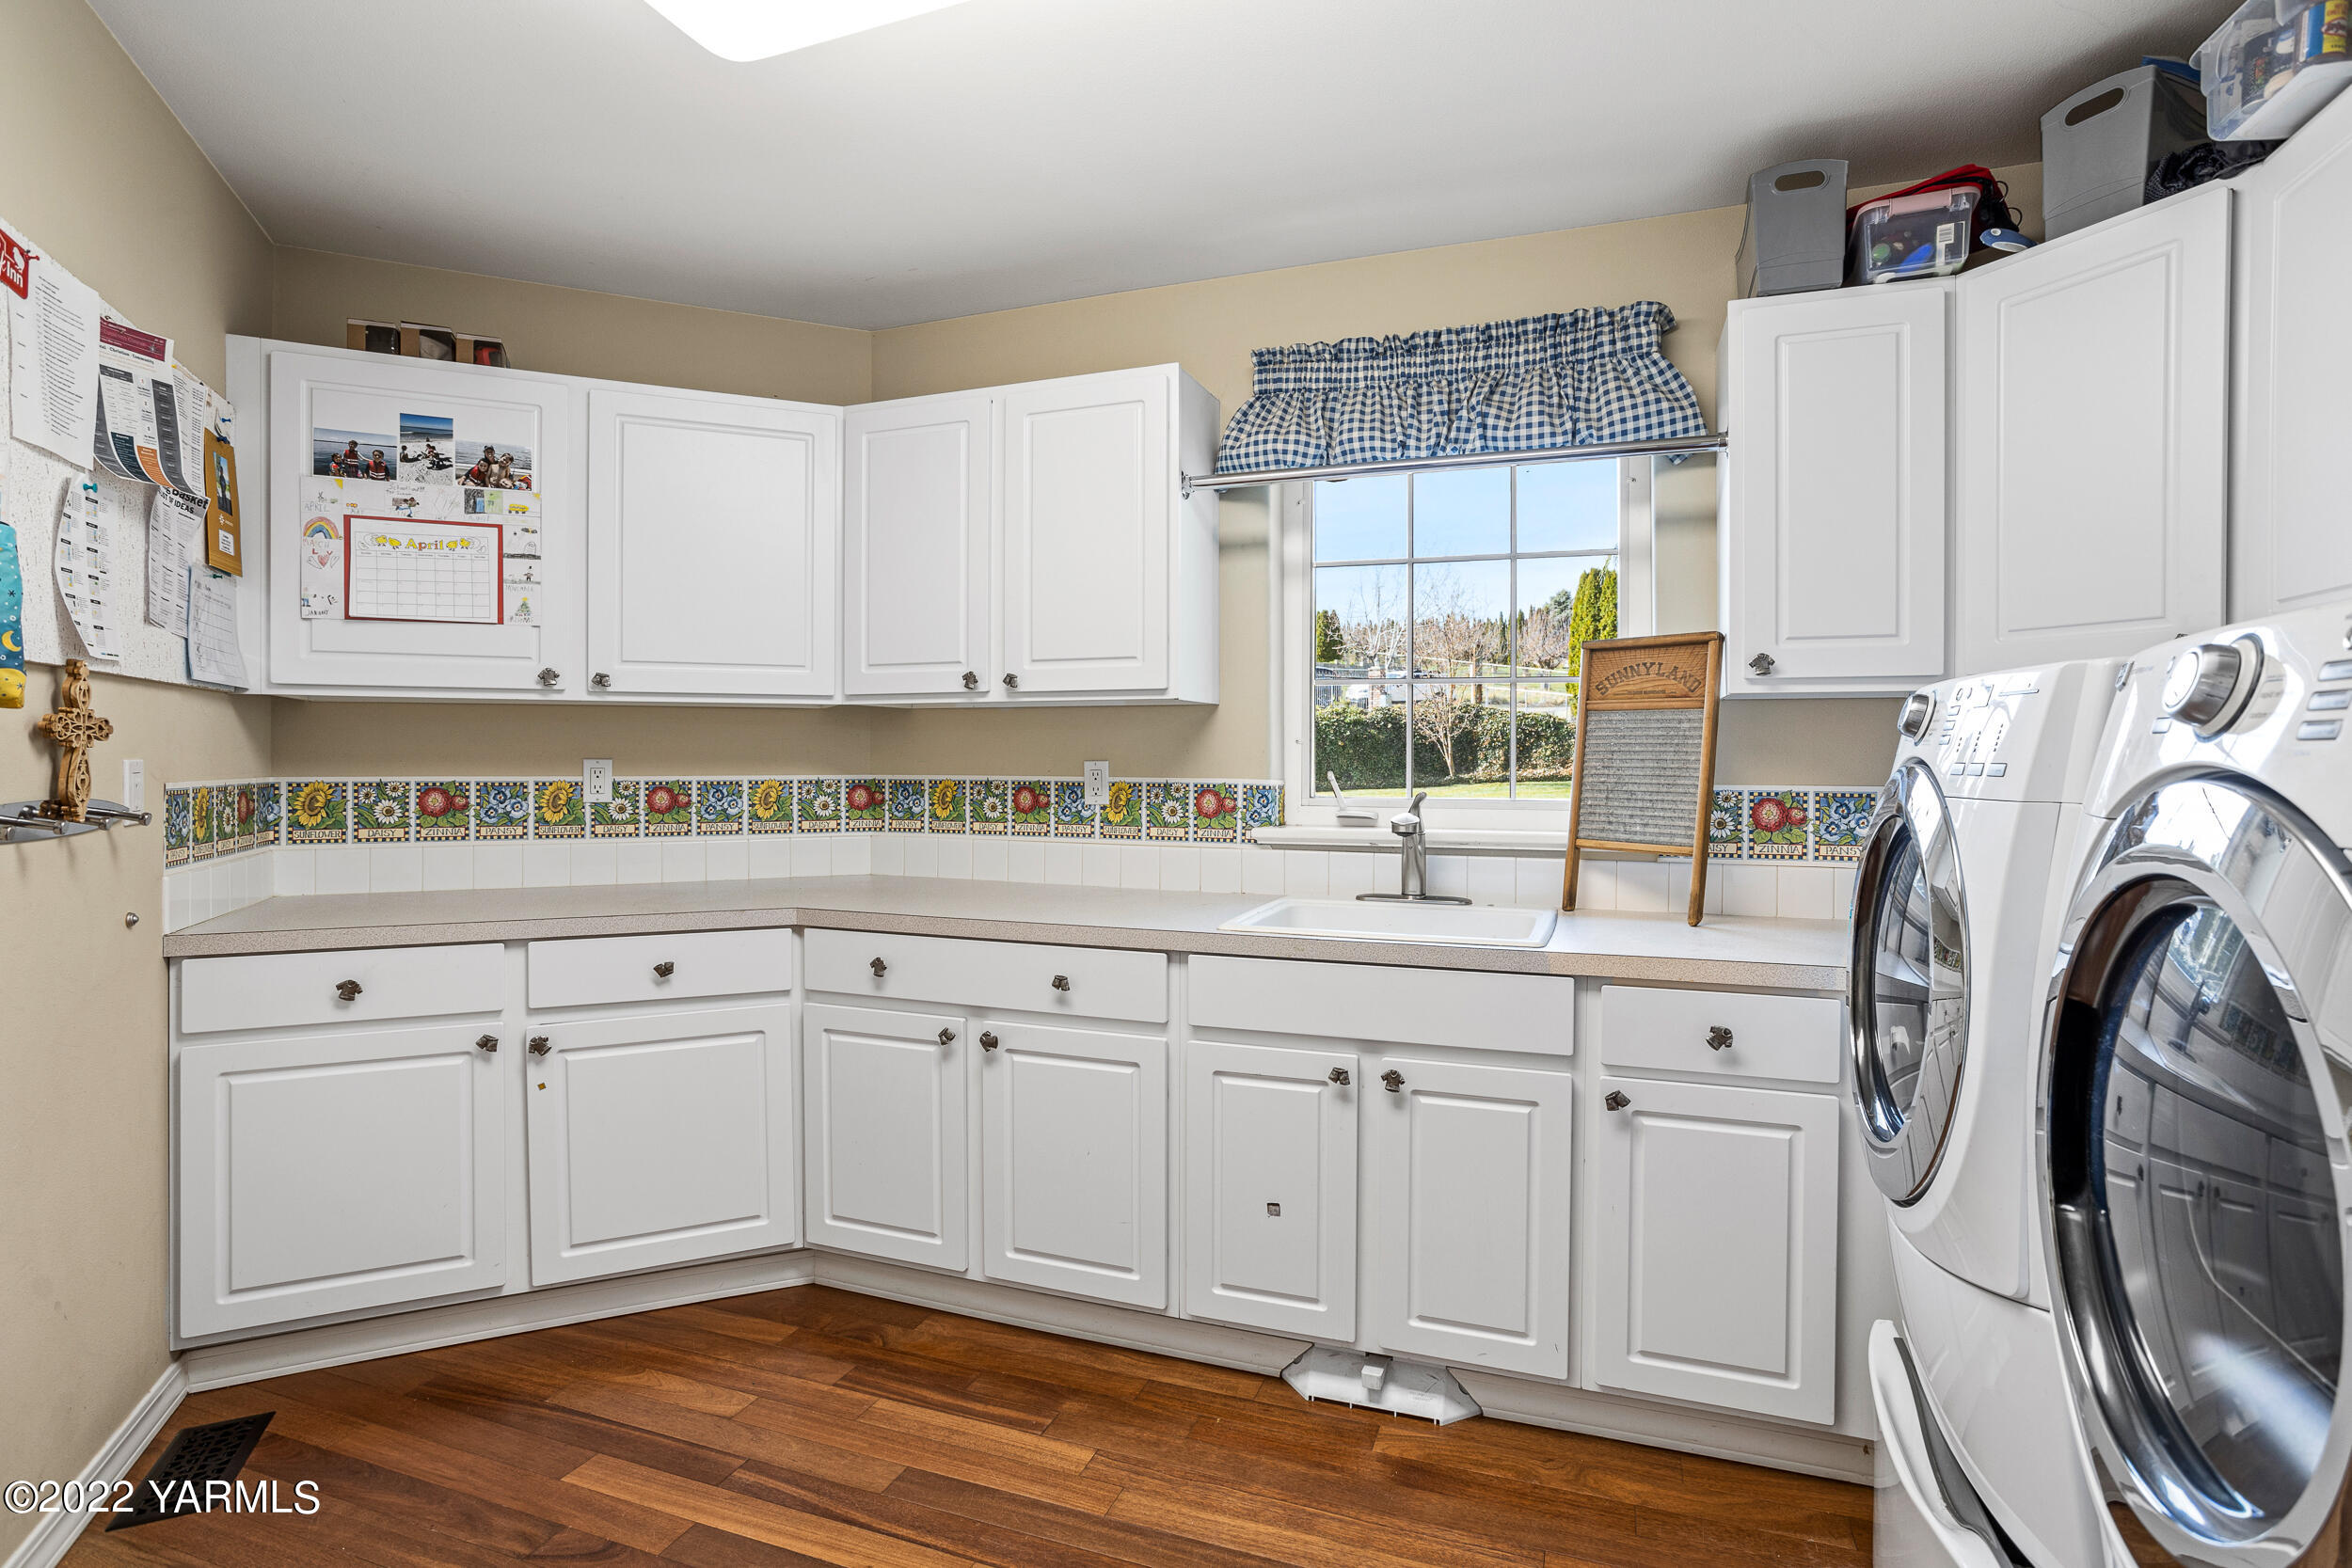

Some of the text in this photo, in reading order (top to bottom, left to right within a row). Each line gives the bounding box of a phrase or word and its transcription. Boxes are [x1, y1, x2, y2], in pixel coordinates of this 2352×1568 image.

[405, 538, 444, 551] April
[1596, 661, 1702, 696] SUNNYLAND
[653, 824, 687, 832] ZINNIA
[705, 823, 735, 832] PANSY
[808, 820, 831, 829] DAISY
[851, 819, 882, 828] ZINNIA
[895, 820, 920, 829] PANSY
[978, 823, 999, 832] DAISY
[1018, 824, 1046, 832] ZINNIA
[368, 829, 398, 837] DAISY
[425, 826, 464, 836] ZINNIA
[485, 827, 519, 835] PANSY
[539, 825, 580, 834] SUNFLOWER
[603, 824, 628, 833] DAISY
[1061, 825, 1089, 833] PANSY
[1104, 826, 1137, 835] SUNFLOWER
[1156, 828, 1180, 836] DAISY
[1200, 829, 1232, 837] ZINNIA
[294, 830, 342, 840] SUNFLOWER
[1758, 844, 1801, 854] ZINNIA
[170, 848, 187, 861] PANSY
